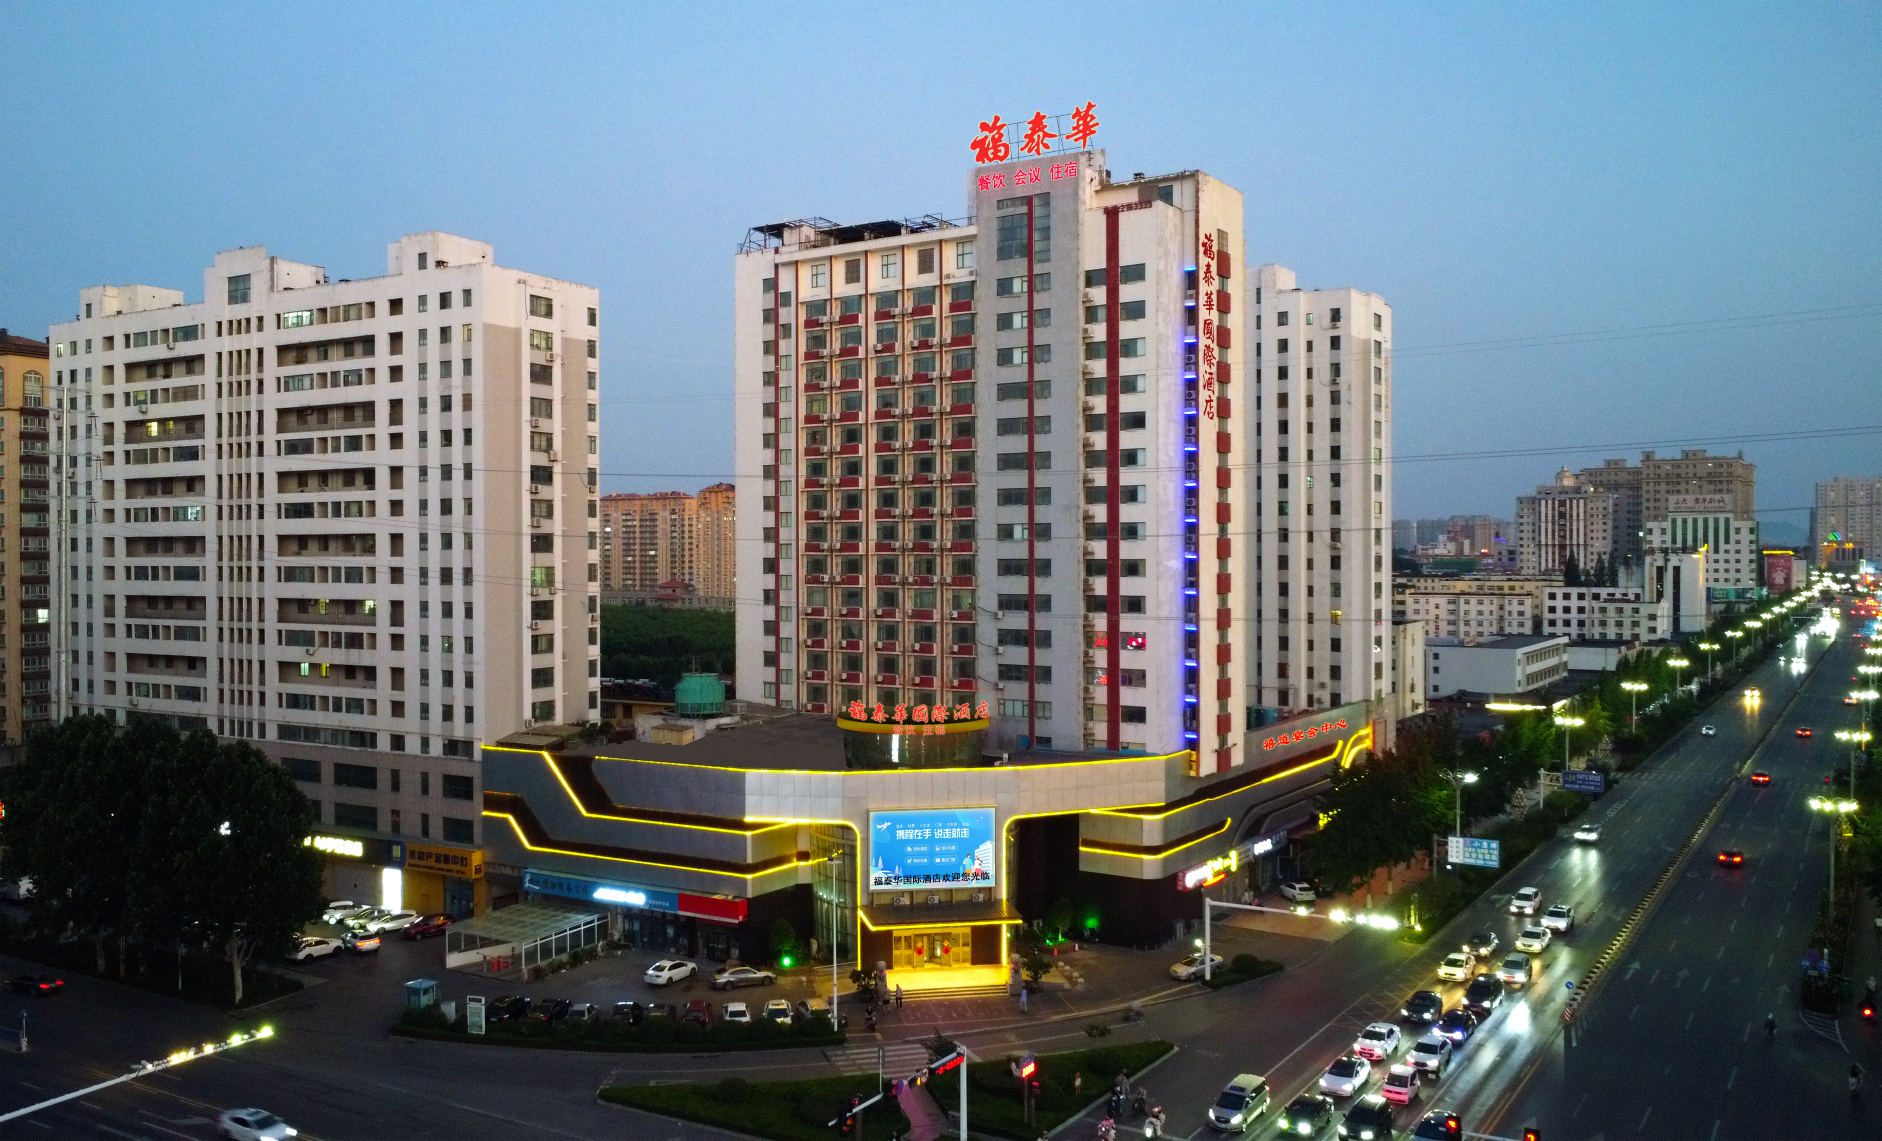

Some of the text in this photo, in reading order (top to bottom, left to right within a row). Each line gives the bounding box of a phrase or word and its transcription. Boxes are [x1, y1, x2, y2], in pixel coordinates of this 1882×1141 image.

[970, 100, 1100, 164] 福泰華
[977, 161, 1078, 191] 餐饮 会议 住宿
[892, 724, 946, 735] 餐饮 住宿
[895, 827, 970, 840] 携程在手 说走就走
[873, 871, 990, 886] 福泰华国际酒店欢迎您光临
